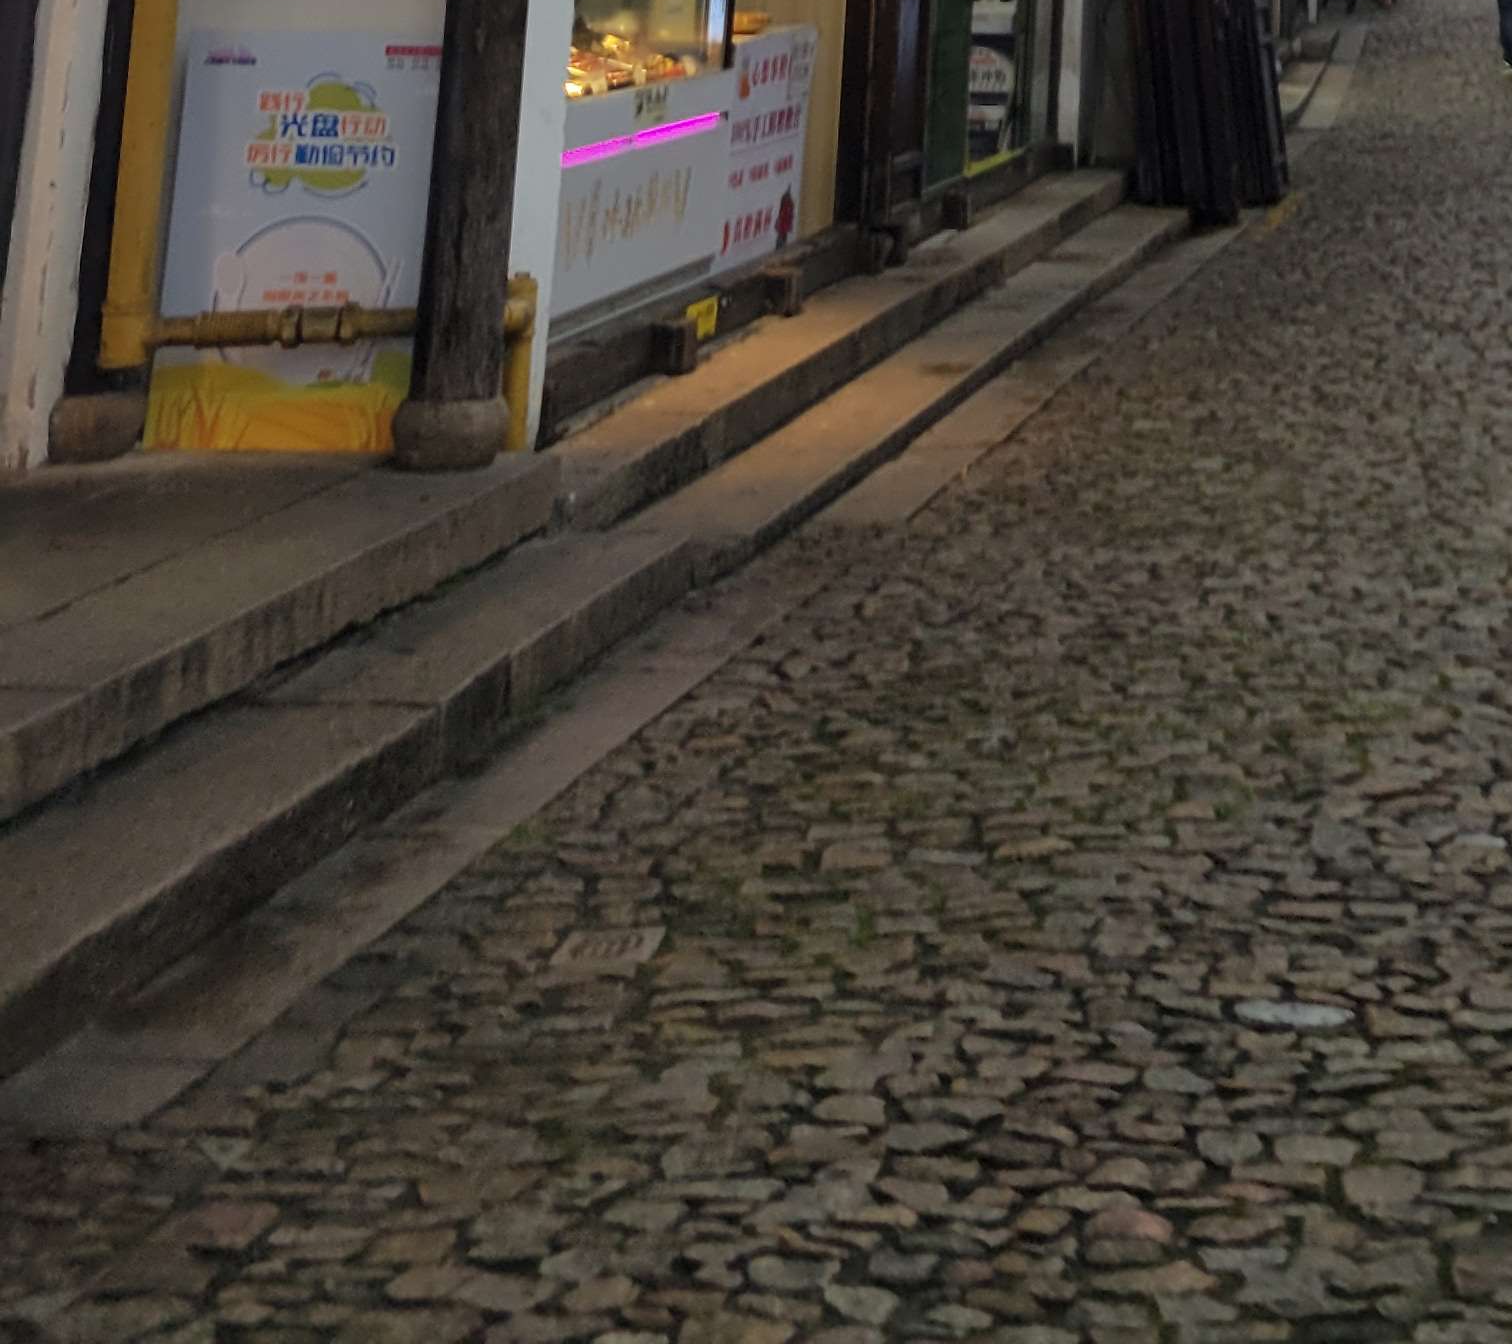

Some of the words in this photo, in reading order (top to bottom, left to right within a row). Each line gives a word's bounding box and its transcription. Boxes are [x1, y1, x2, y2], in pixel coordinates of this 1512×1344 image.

[280, 111, 387, 138] 光盘行动
[246, 143, 396, 167] 厉行勤俭节约
